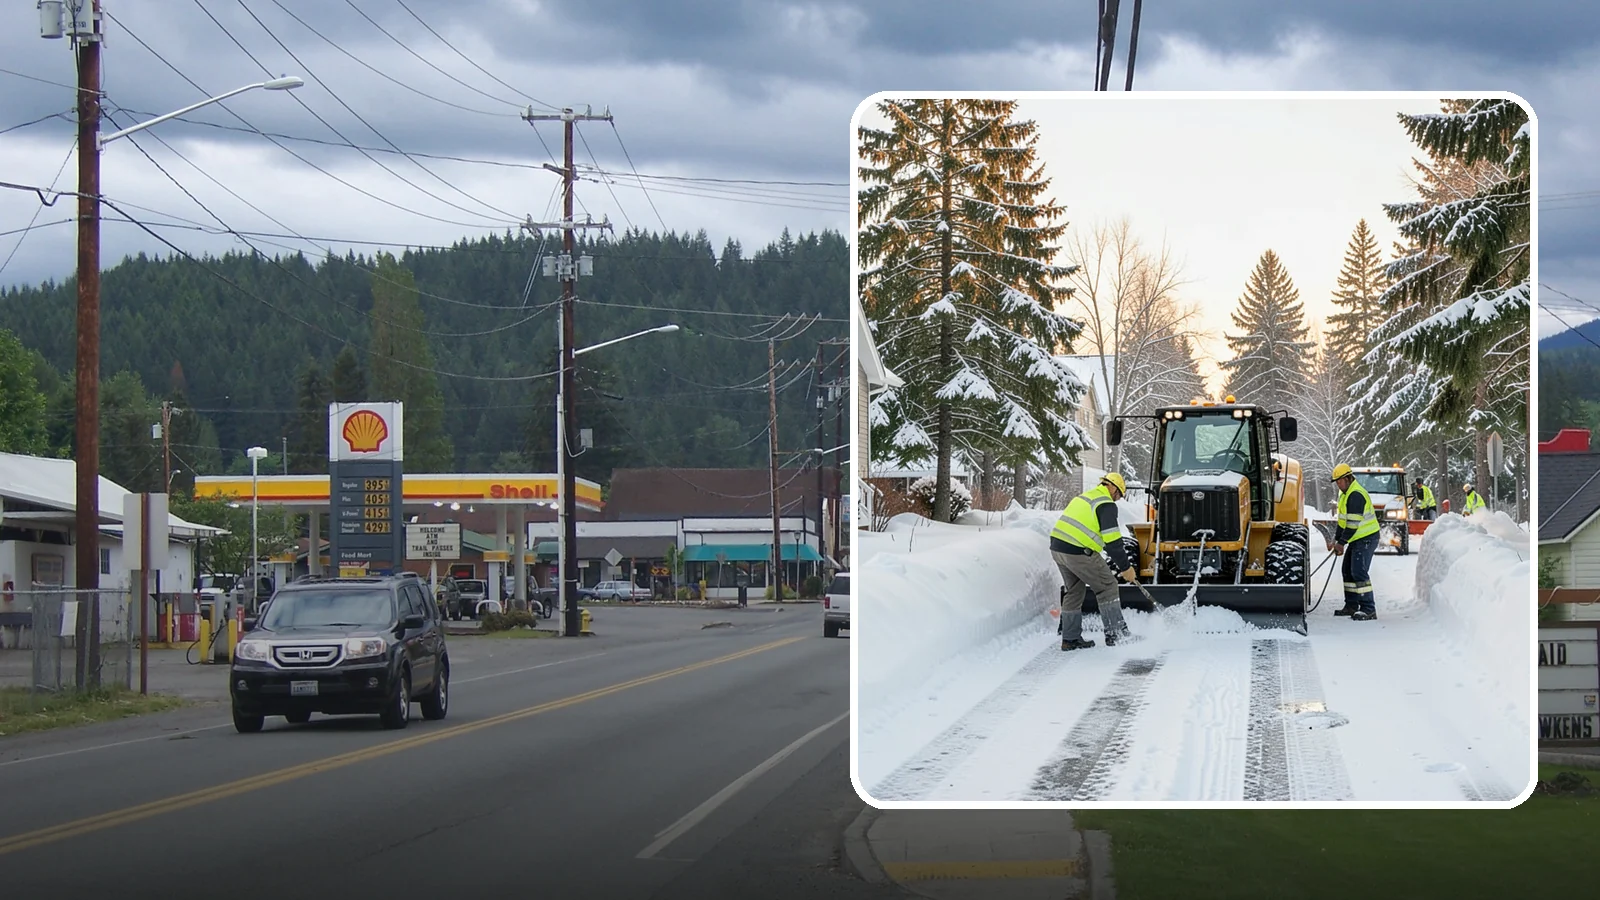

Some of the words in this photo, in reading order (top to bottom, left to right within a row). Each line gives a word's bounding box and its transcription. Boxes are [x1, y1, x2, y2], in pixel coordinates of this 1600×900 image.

[365, 480, 383, 490] 395
[490, 484, 547, 499] Shell
[365, 494, 383, 504] 405
[365, 508, 383, 518] 415
[365, 522, 383, 533] 429
